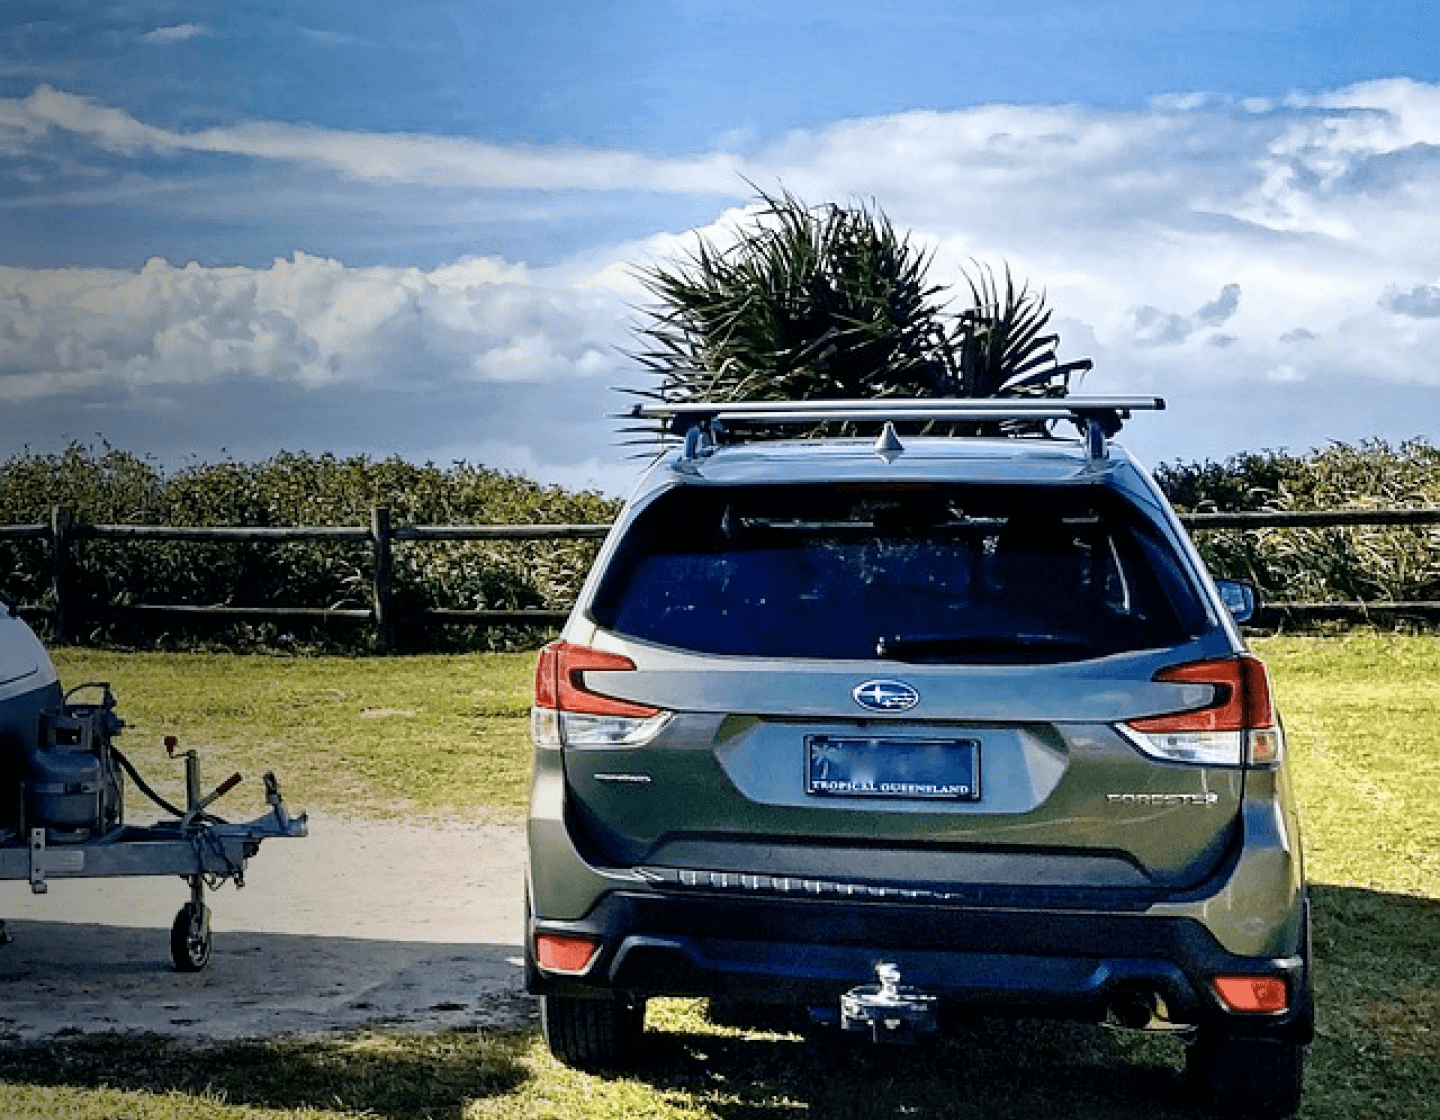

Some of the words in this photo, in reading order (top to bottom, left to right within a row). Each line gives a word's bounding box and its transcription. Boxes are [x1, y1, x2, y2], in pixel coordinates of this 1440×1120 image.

[811, 780, 878, 792] TROPICAL
[880, 782, 970, 794] QUEENSLAND
[1106, 793, 1219, 808] FORESTER
